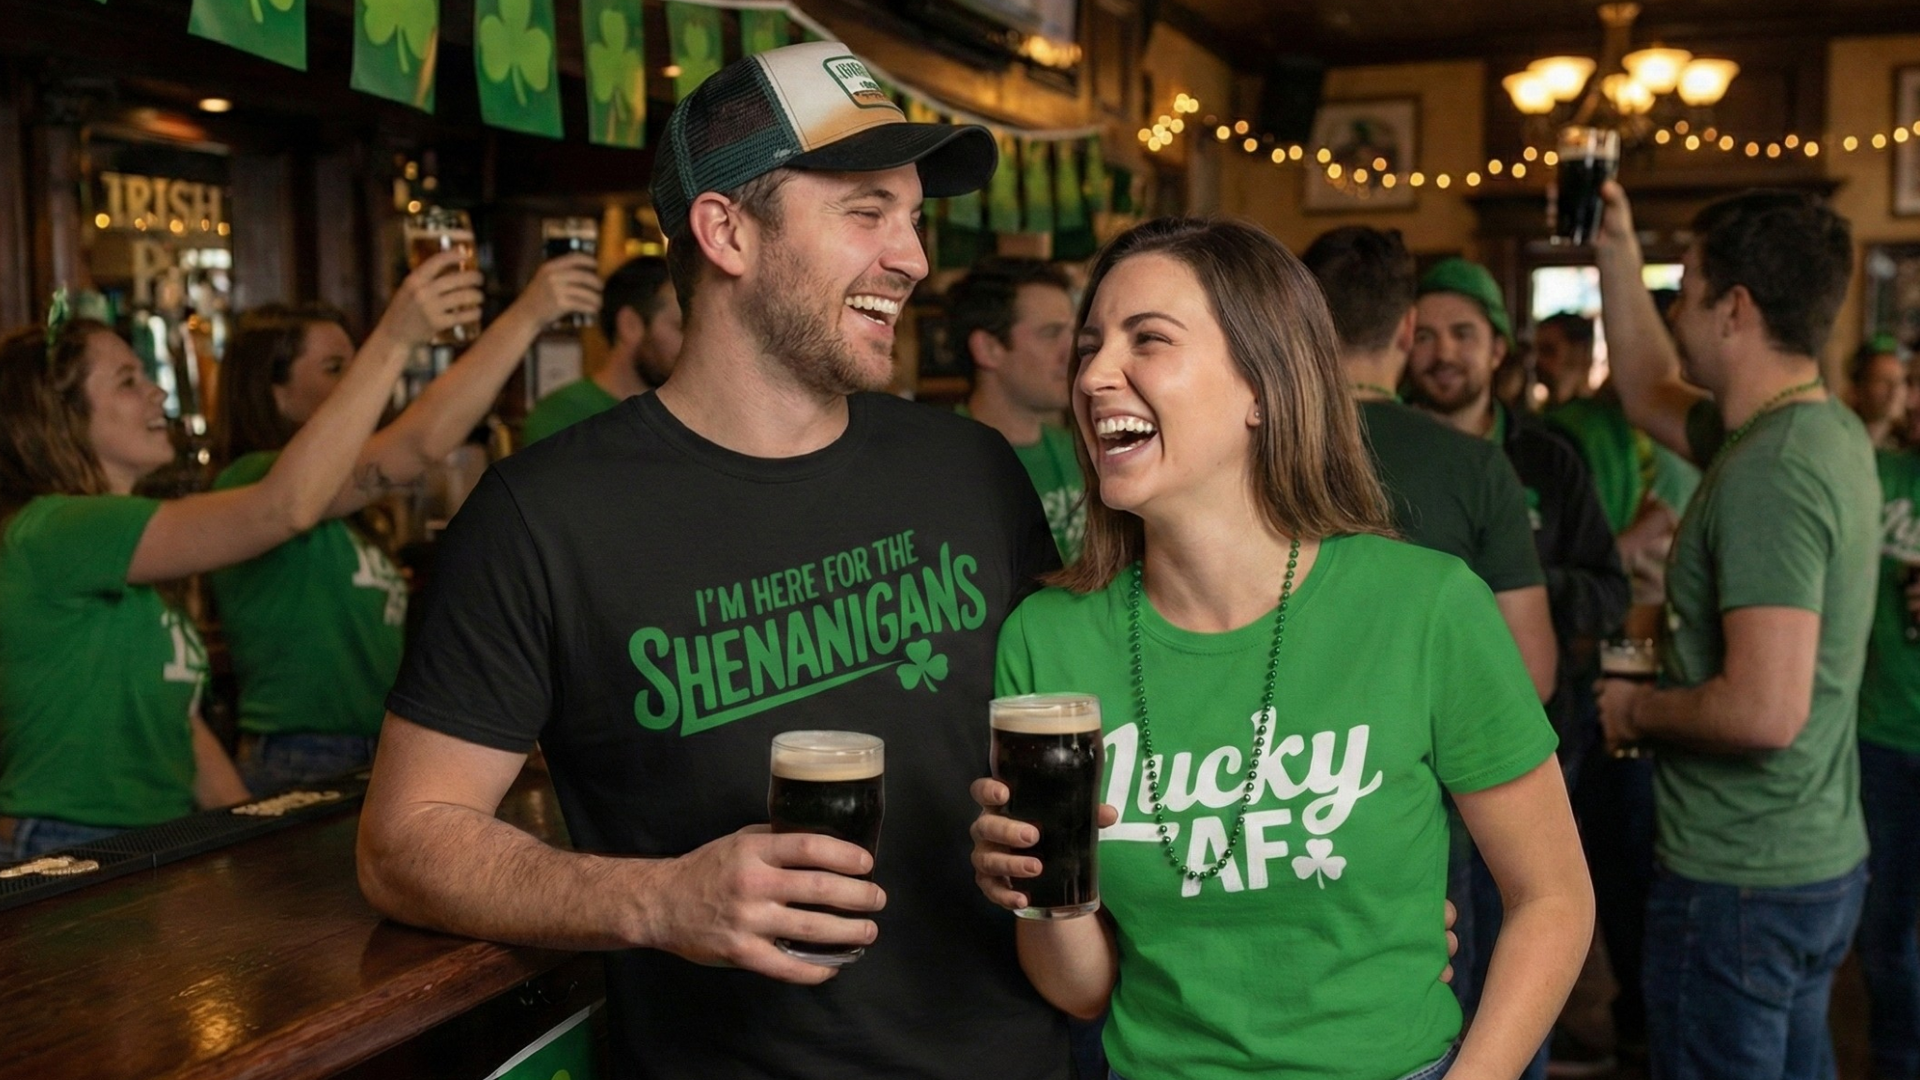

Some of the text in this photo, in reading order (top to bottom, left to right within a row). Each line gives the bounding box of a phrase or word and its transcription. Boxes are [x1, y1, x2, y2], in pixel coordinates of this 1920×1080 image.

[101, 171, 222, 231] IRISH
[694, 529, 919, 627] I'M HERE FOR THE
[628, 541, 987, 737] SHENANIGANS
[1099, 705, 1384, 843] Lucky
[1181, 808, 1293, 898] AF
